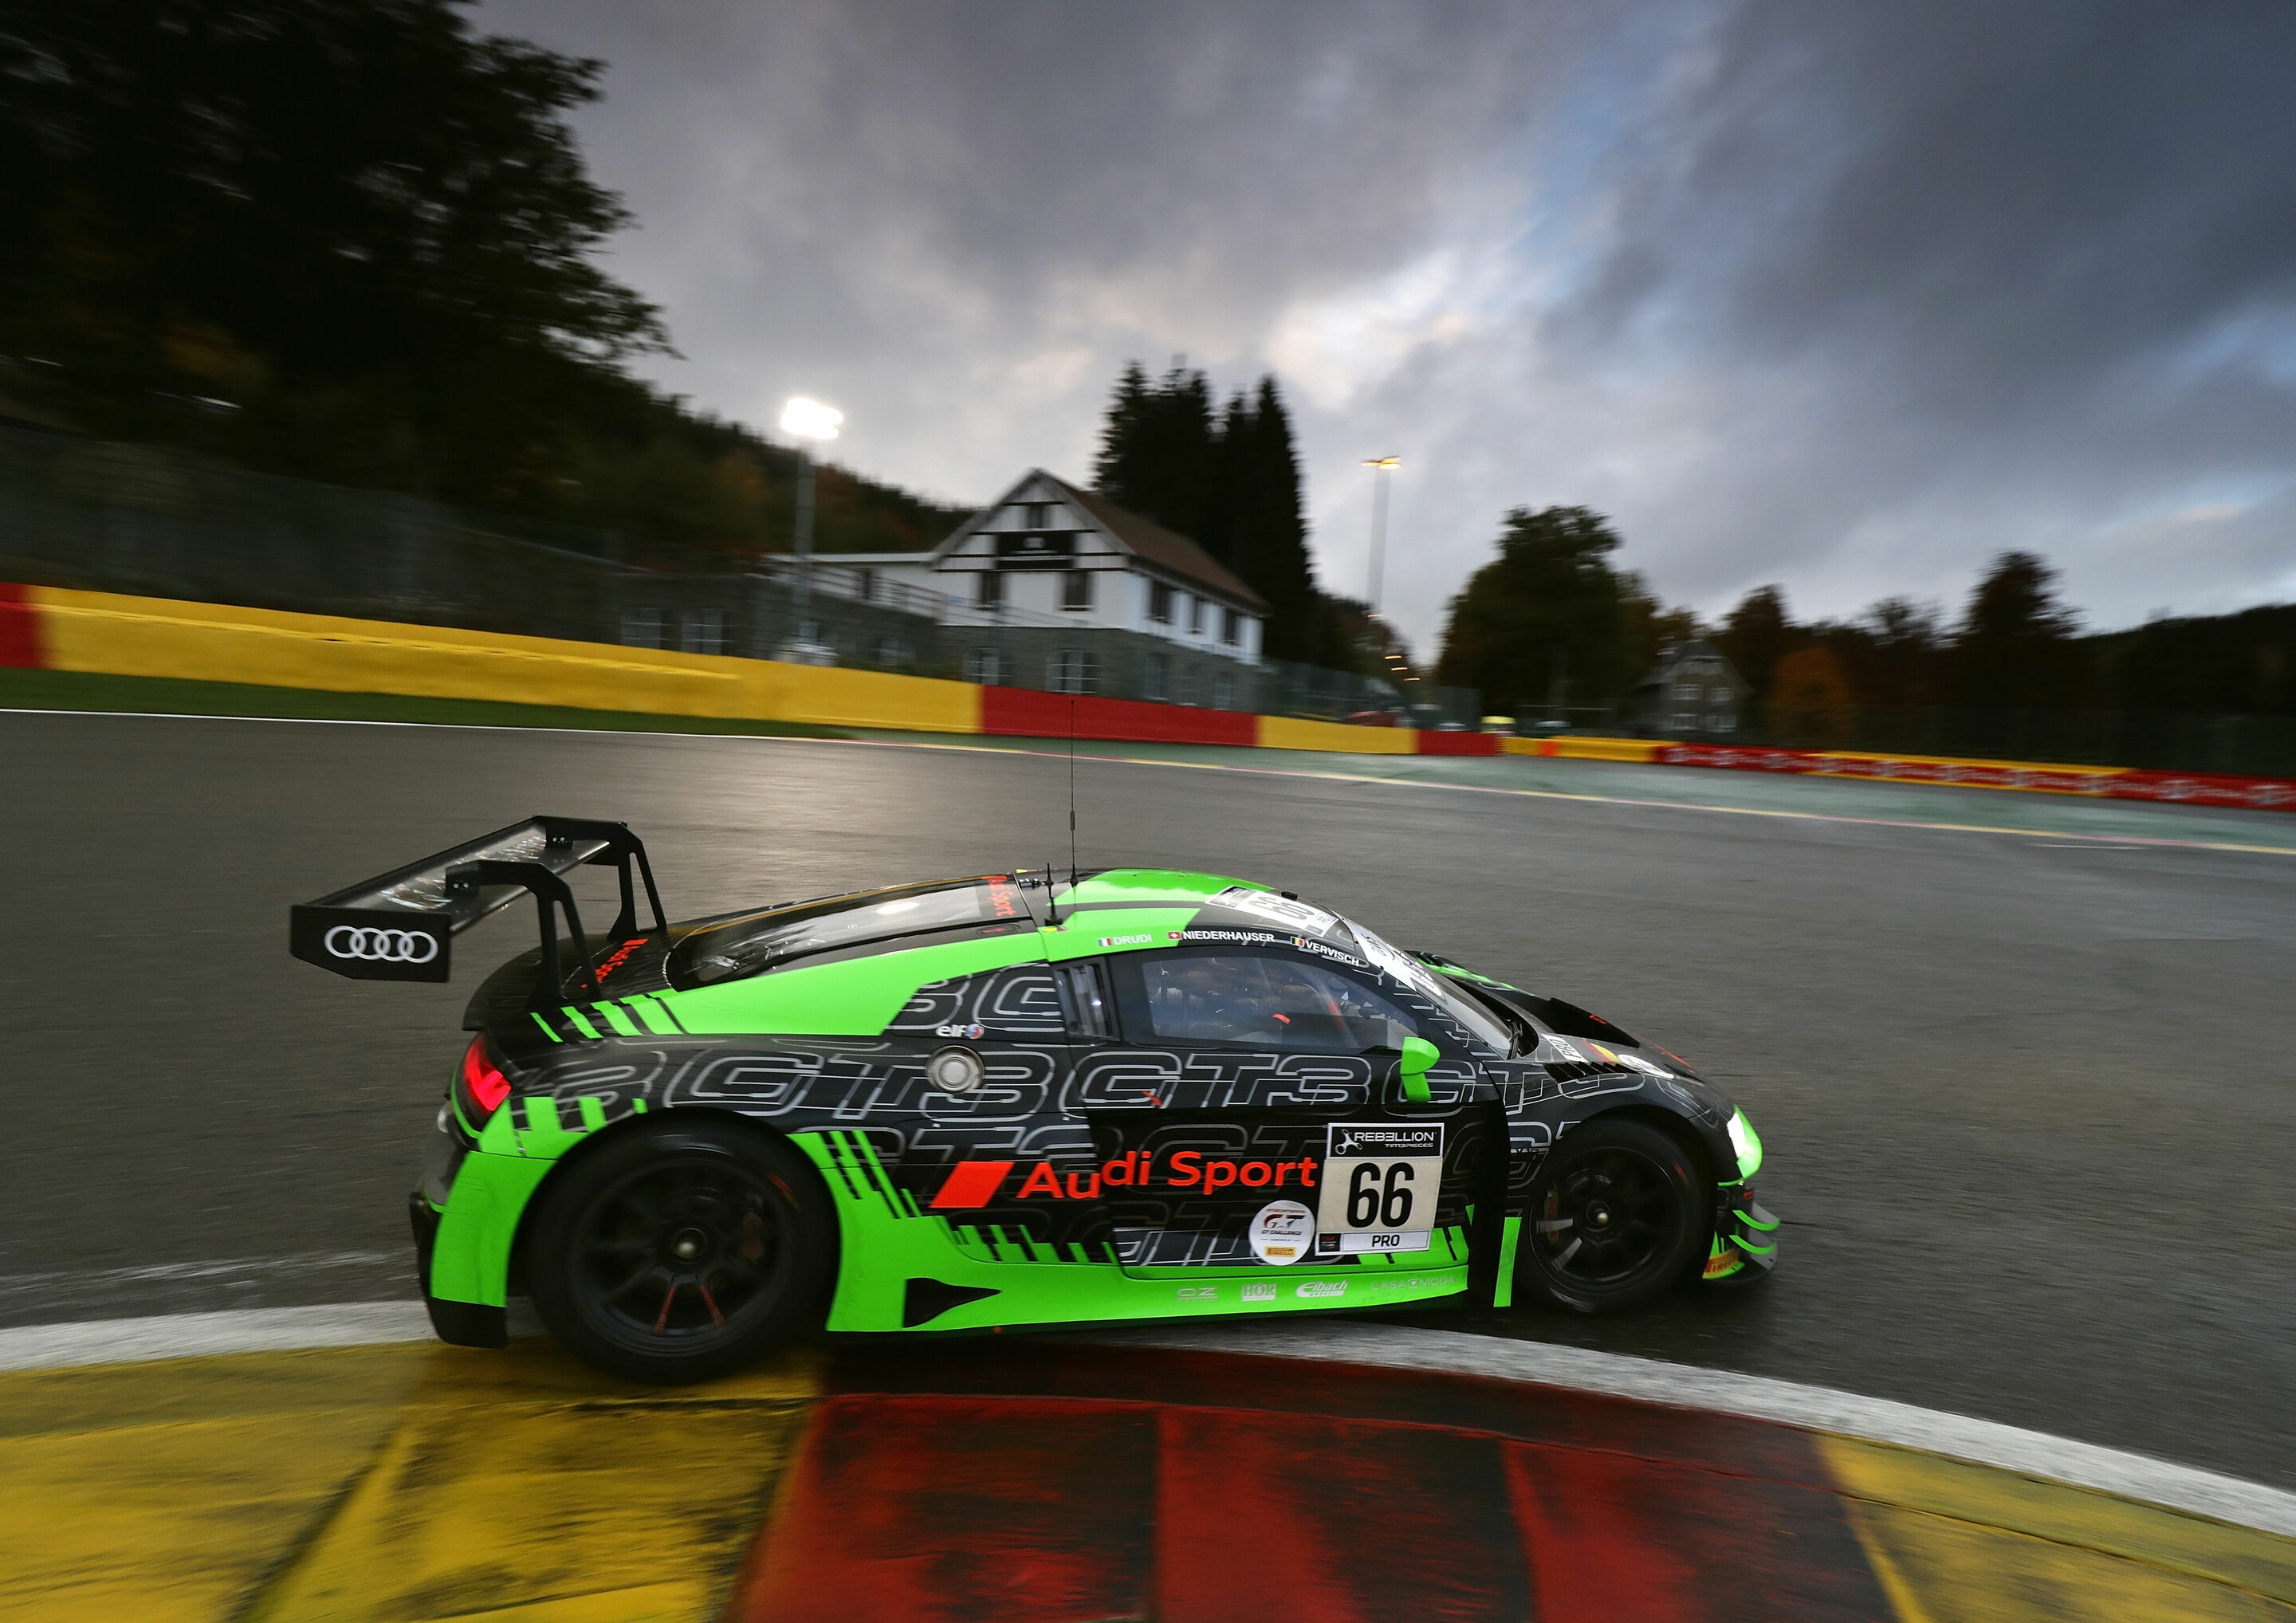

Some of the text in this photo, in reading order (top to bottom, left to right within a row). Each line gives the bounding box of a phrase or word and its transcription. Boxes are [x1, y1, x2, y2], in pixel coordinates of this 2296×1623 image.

[1114, 933, 1152, 945] DRUDI
[1182, 930, 1276, 942] NIEDERHAUSER
[1305, 941, 1360, 967] VERVISCH
[1016, 1150, 1319, 1198] Audi Sport
[1347, 1162, 1414, 1228] 66
[1371, 1234, 1400, 1247] PRO
[1295, 1280, 1348, 1298] Eibach
[1370, 1275, 1457, 1291] CASA MODA
